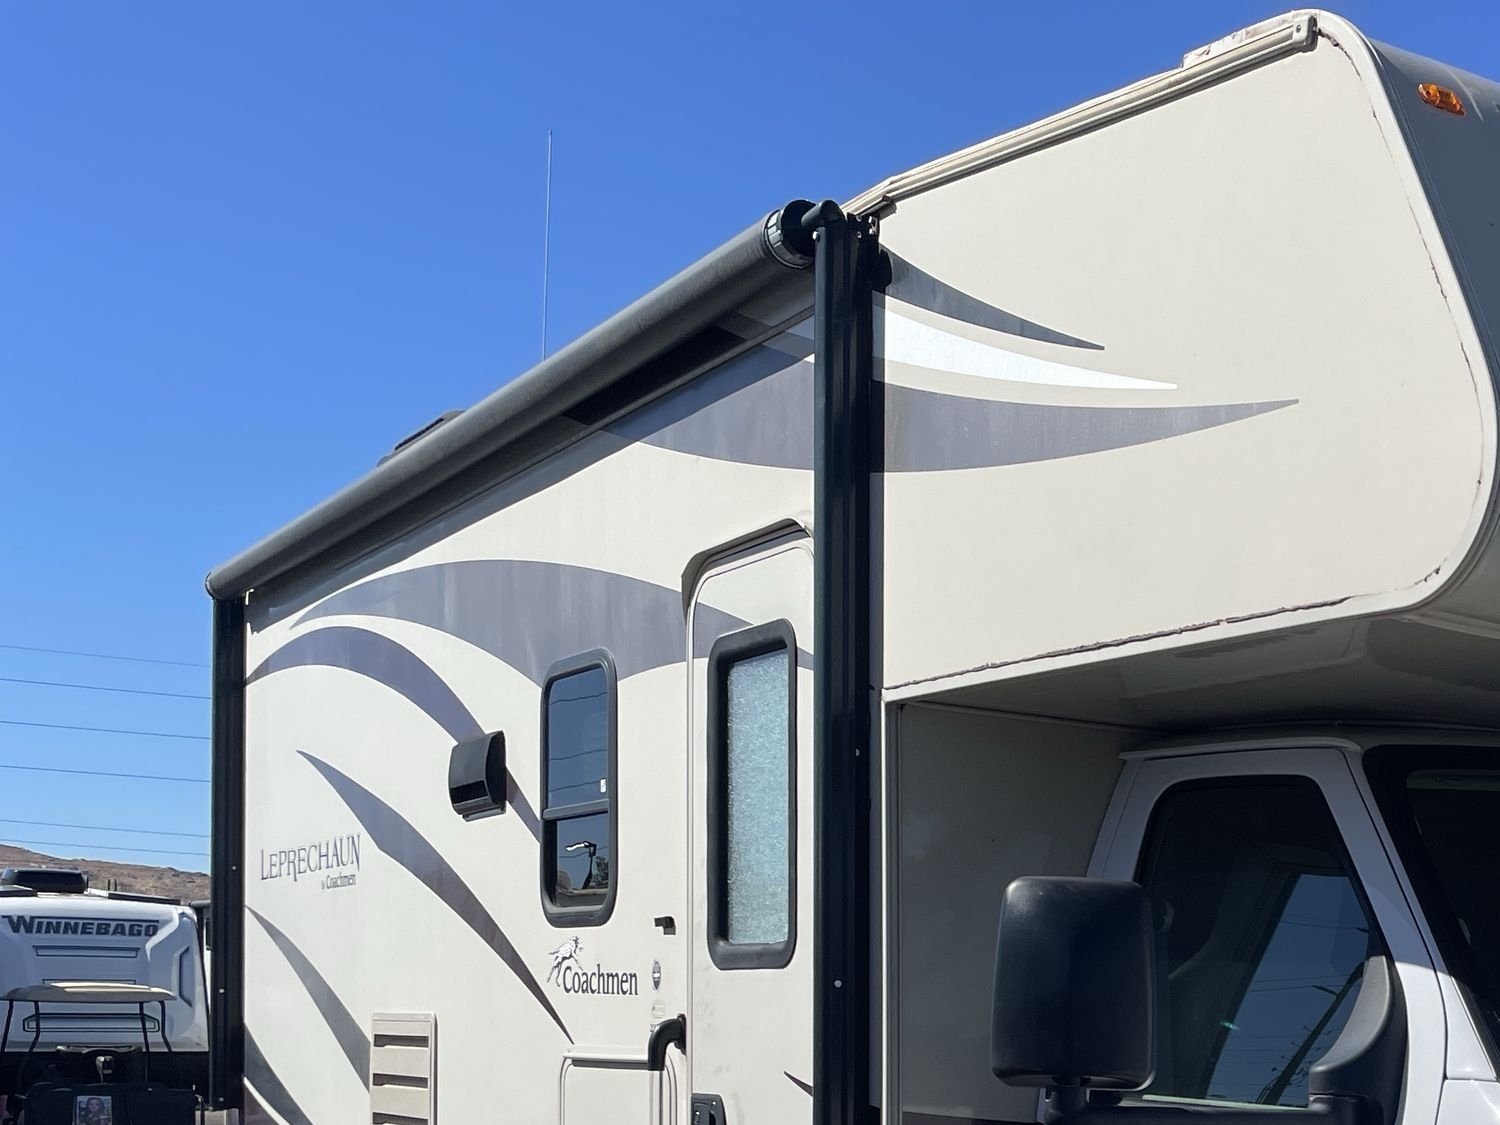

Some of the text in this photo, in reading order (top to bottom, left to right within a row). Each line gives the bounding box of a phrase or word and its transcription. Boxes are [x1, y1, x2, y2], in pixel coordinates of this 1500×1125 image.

[261, 832, 361, 882] LEPRECHAUN
[326, 871, 357, 889] Coachmen
[7, 914, 160, 938] WINNEBAGO
[563, 963, 639, 996] Coachmen
